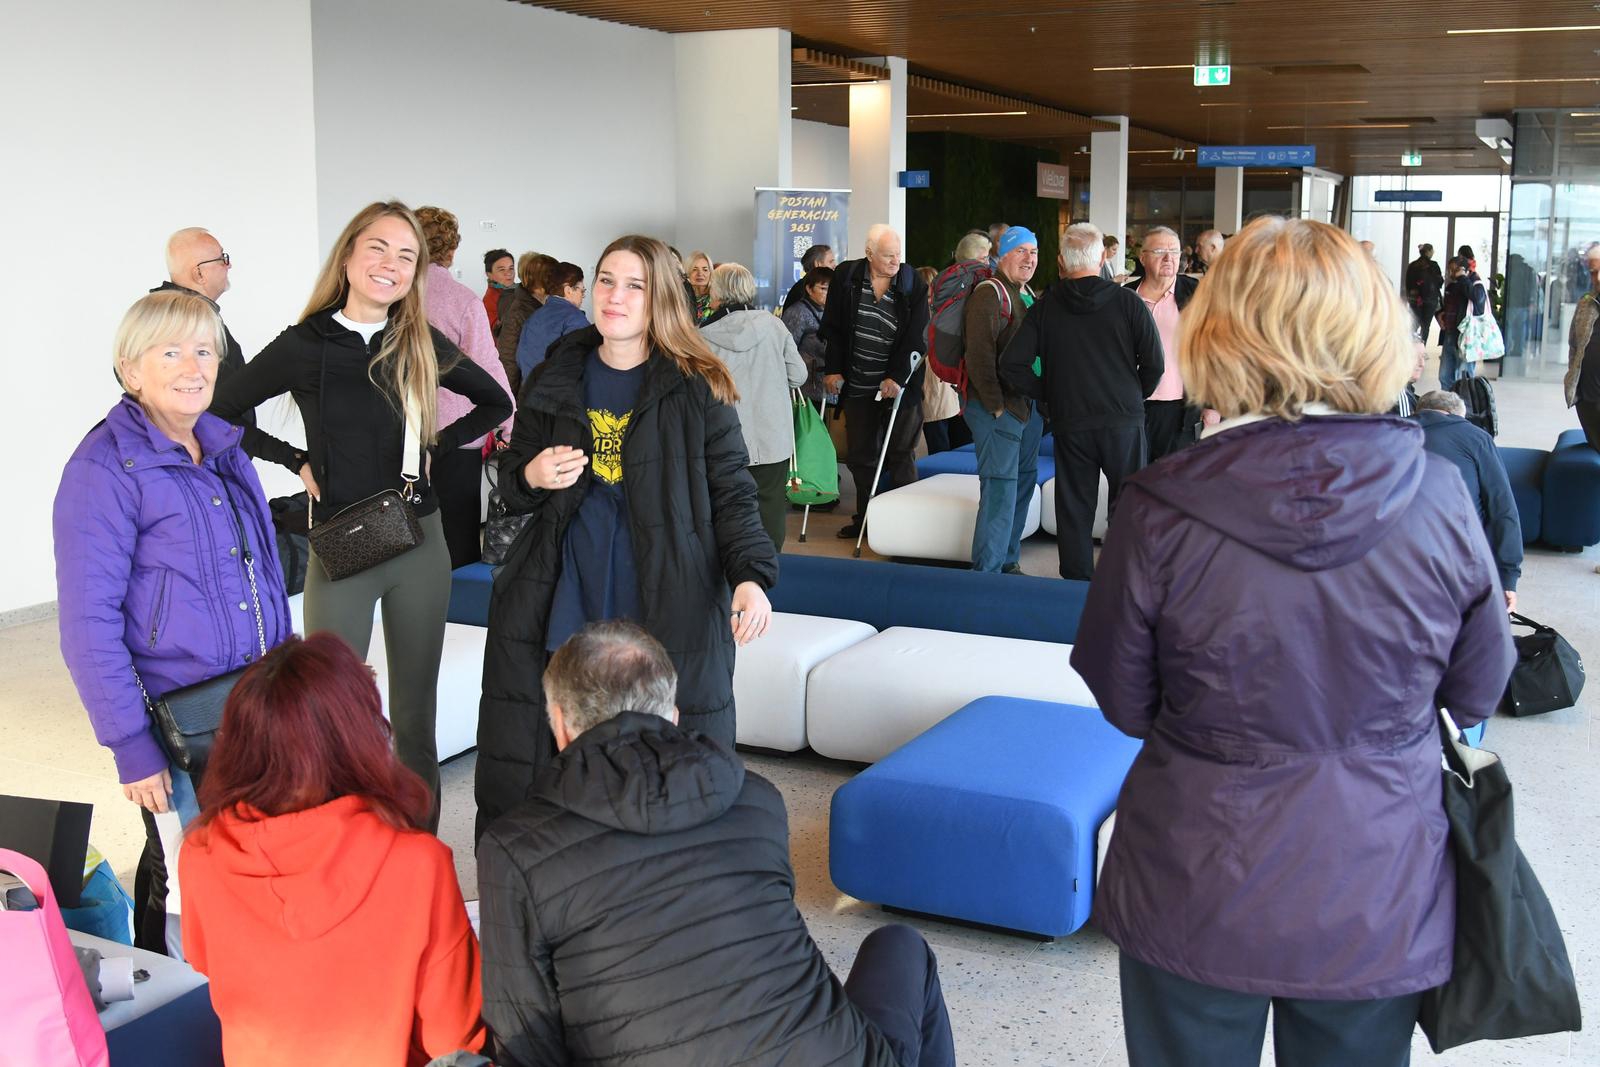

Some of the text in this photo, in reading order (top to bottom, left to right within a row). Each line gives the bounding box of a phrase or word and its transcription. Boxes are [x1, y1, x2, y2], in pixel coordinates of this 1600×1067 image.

[780, 196, 827, 207] POSTANI
[767, 209, 839, 221] GENERACIJA
[790, 223, 816, 233] 365!
